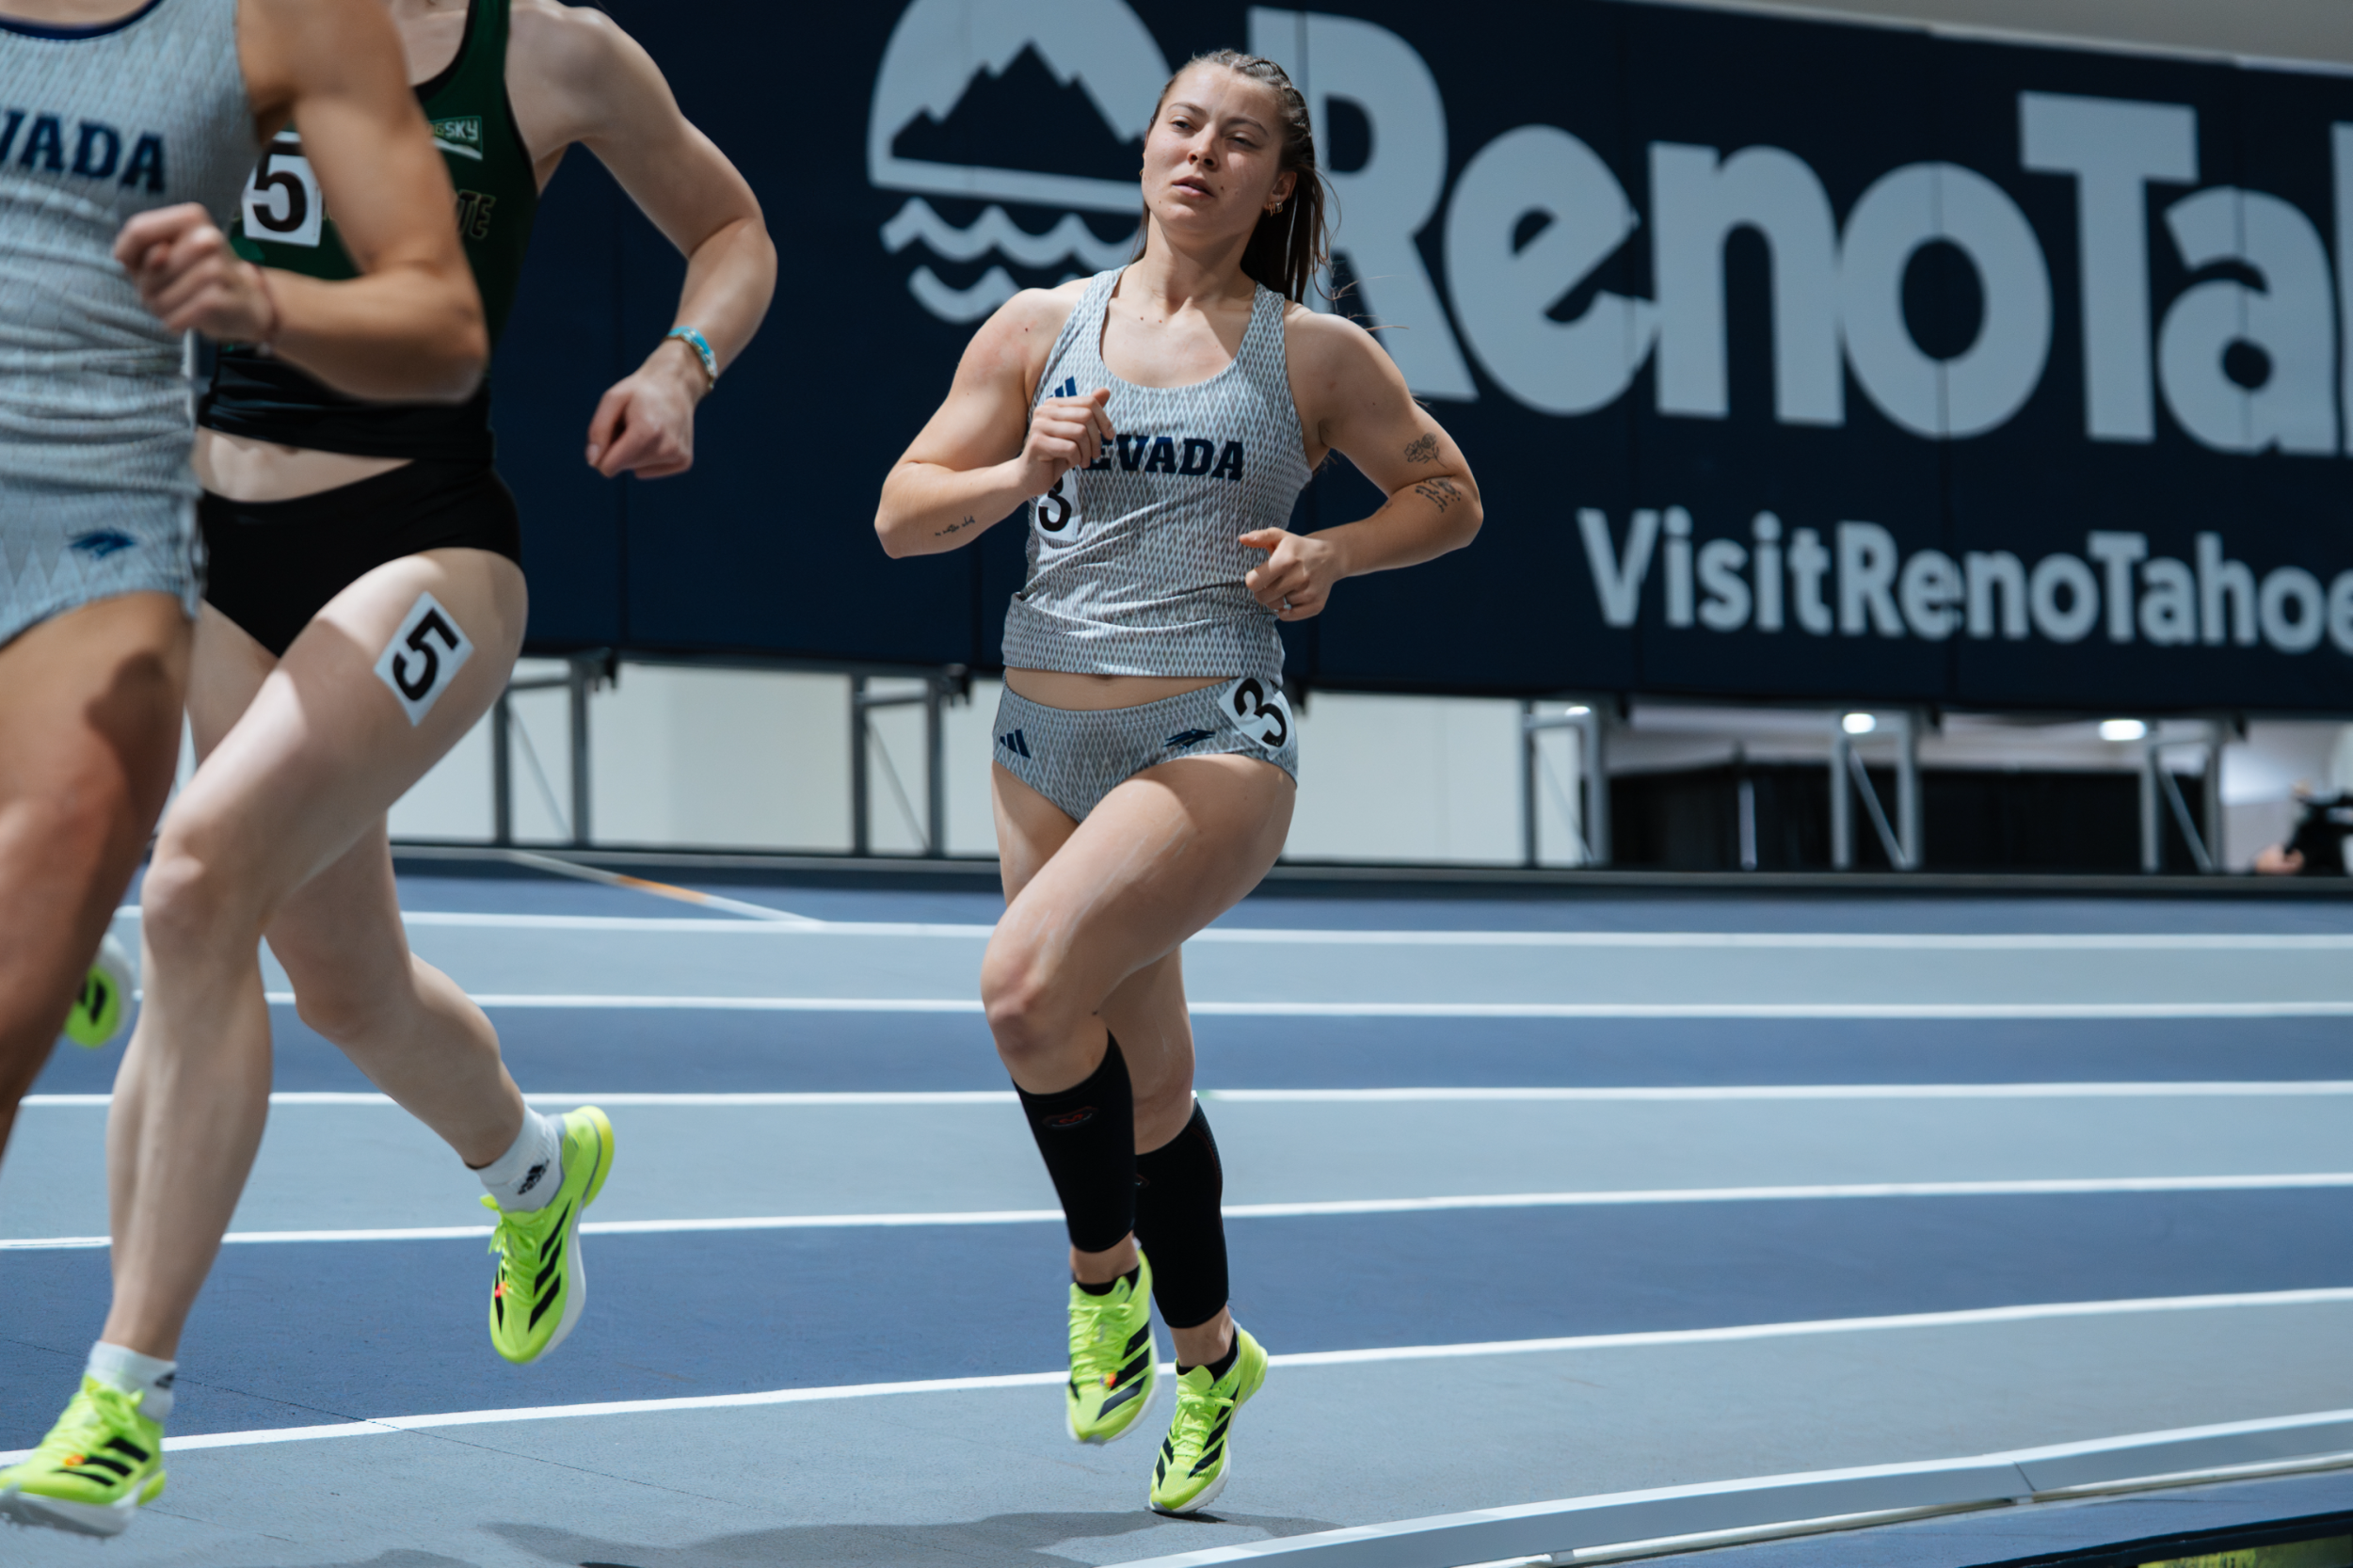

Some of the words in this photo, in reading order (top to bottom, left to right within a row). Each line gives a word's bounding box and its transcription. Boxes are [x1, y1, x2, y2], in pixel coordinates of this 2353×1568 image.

[251, 140, 308, 232] 5
[1248, 7, 2353, 456] RenoTa
[1084, 433, 1244, 482] EVADA
[1038, 476, 1072, 532] 3
[392, 606, 461, 702] 5
[1233, 678, 1287, 747] 3
